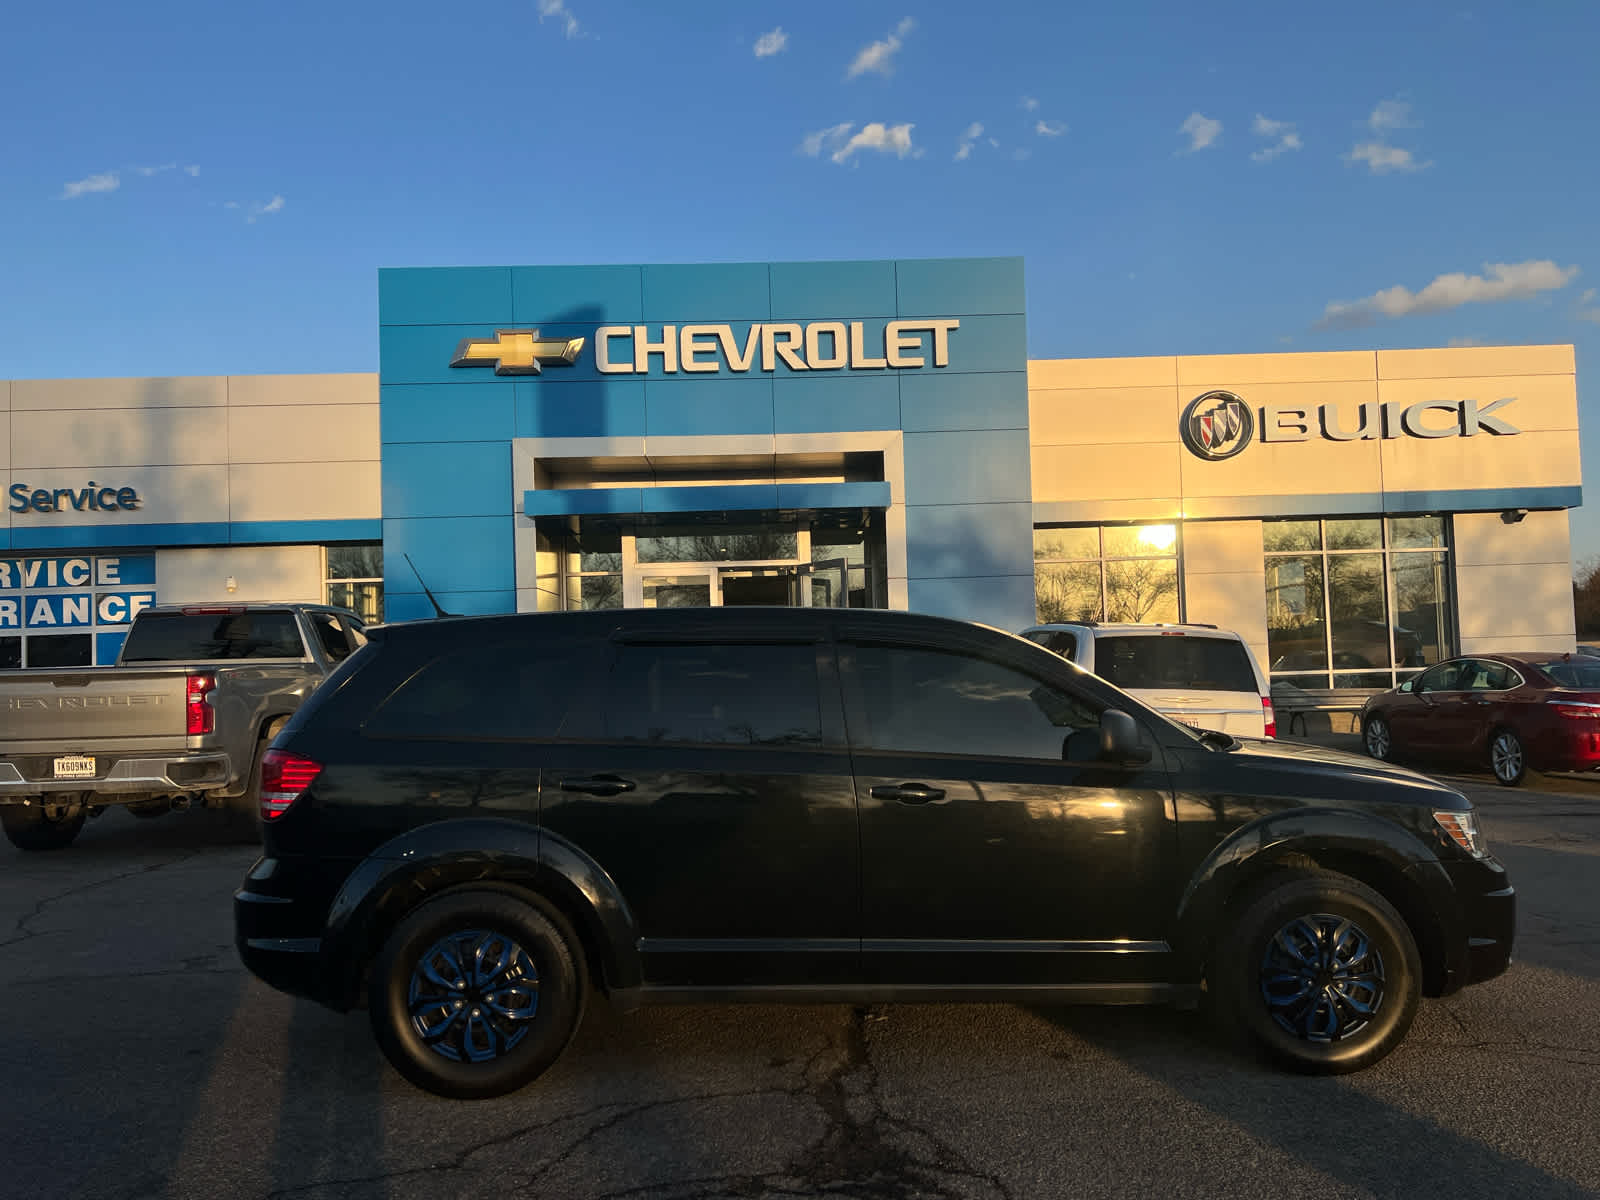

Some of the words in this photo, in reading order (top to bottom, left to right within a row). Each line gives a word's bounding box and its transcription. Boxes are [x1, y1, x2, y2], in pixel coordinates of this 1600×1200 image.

[595, 320, 960, 374] CHEVROLET
[1258, 397, 1521, 443] BUICK
[8, 480, 139, 512] Service
